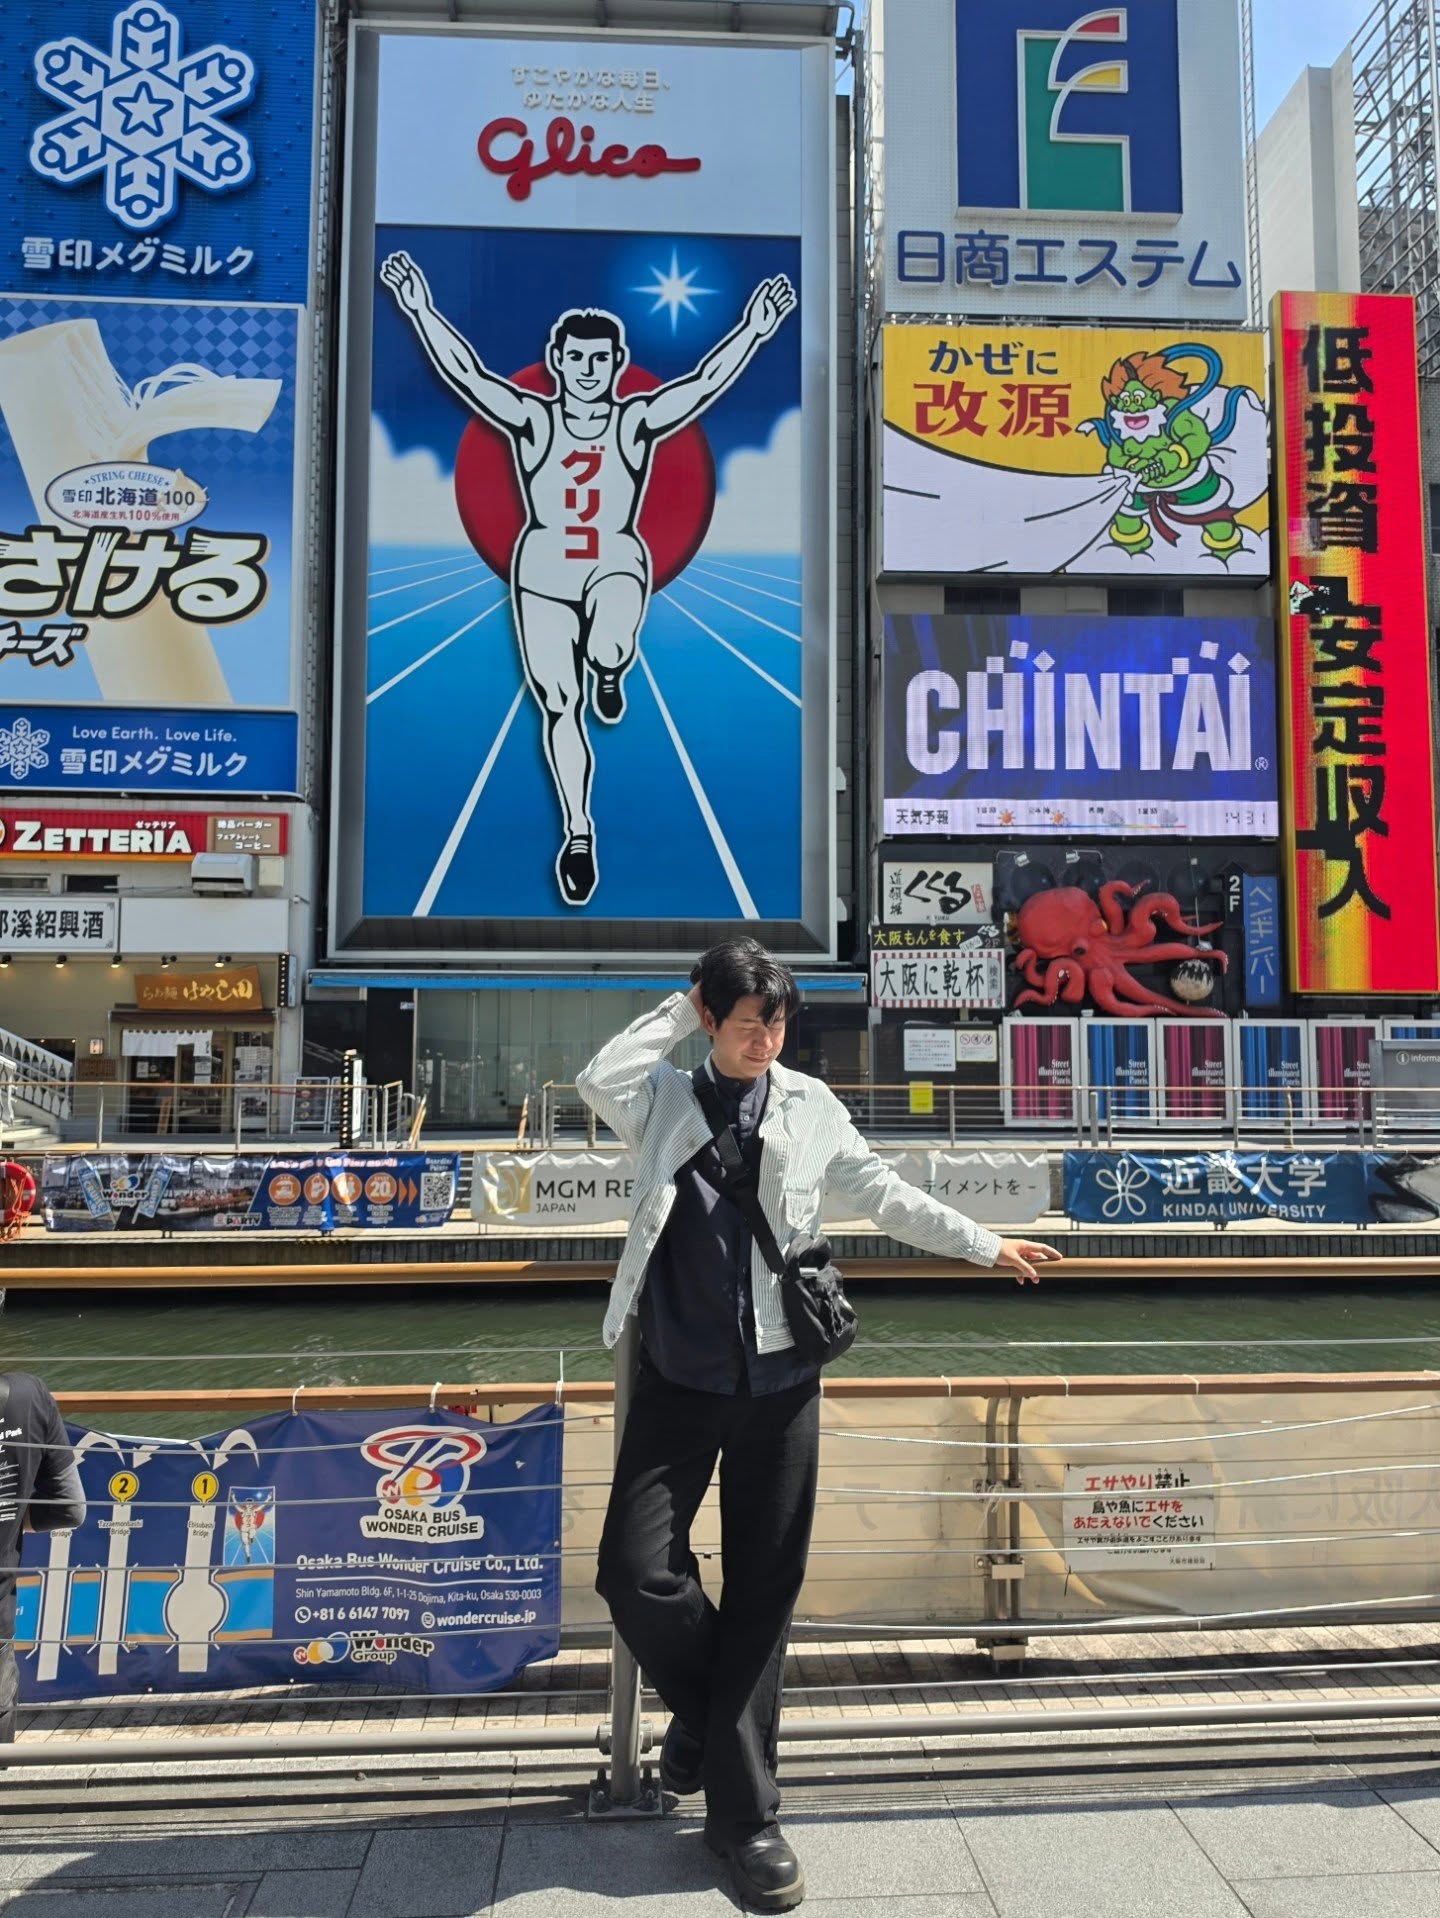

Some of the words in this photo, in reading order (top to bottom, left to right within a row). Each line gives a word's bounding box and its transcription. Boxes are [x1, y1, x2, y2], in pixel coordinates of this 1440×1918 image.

[523, 92, 655, 114] ゆたかな人生
[478, 117, 701, 202] Glico
[22, 236, 254, 275] 雪印メグミルク
[898, 230, 1241, 288] 日商エステム
[928, 340, 1058, 375] かぜに
[913, 381, 1076, 438] 改源
[90, 471, 125, 485] STRING
[128, 471, 165, 486] CHEESE
[560, 445, 605, 560] グリコ
[0, 528, 264, 621] さける
[906, 642, 1252, 775] CHINTAI
[72, 726, 107, 740] Love
[111, 726, 159, 740] Earth.
[165, 728, 201, 742] Love
[204, 728, 238, 743] Life.
[60, 746, 248, 777] 雪印メグミルク
[135, 820, 176, 829] ゼッテリア
[896, 808, 949, 825] 天気予報
[13, 821, 192, 854] ZETTERIA
[235, 842, 272, 851] コーヒー
[903, 869, 972, 915] くくる
[1229, 875, 1241, 913] 2F
[874, 928, 966, 947] 大阪もんを食す
[984, 938, 1001, 949] 2F
[880, 959, 985, 998] 大阪に乾杯
[1051, 1059, 1069, 1068] Street
[1128, 1059, 1146, 1068] Street
[1204, 1060, 1222, 1068] Street
[1281, 1060, 1299, 1069] Street
[1162, 1156, 1327, 1198] 近畿大学
[103, 1189, 147, 1200] Wonder
[536, 1179, 596, 1199] MGM
[536, 1203, 576, 1213] JAPAN
[1162, 1203, 1224, 1217] KINDAI
[1228, 1202, 1327, 1218] UNIVERSITY
[118, 1478, 129, 1494] 2
[202, 1478, 209, 1494] 1
[1084, 1472, 1191, 1492] エサやり禁止
[384, 1508, 428, 1522] OSAKA
[432, 1509, 461, 1523] BUS
[1092, 1500, 1184, 1514] 鳥や魚にエサを
[366, 1521, 423, 1537] WONDER
[427, 1521, 479, 1538] CRUISE
[1074, 1514, 1205, 1530] あたえないでください
[297, 1554, 343, 1570] Osaka
[347, 1553, 375, 1568] Bus
[378, 1552, 430, 1575] Wonder
[433, 1556, 482, 1575] Cruise
[484, 1554, 511, 1573] Co.,
[515, 1555, 544, 1570] Ltd.
[295, 1588, 315, 1598] Shin
[317, 1587, 360, 1598] Yamamoto
[361, 1585, 382, 1598] Bldg.
[384, 1587, 395, 1599] 6F,
[481, 1590, 504, 1600] Osaka
[505, 1588, 543, 1600] 530-0003
[313, 1608, 335, 1621] +81
[337, 1607, 346, 1620] 6
[349, 1606, 378, 1620] 6147
[382, 1606, 411, 1621] 7097
[437, 1610, 537, 1628] wondercruise.jp
[353, 1650, 396, 1663] Group
